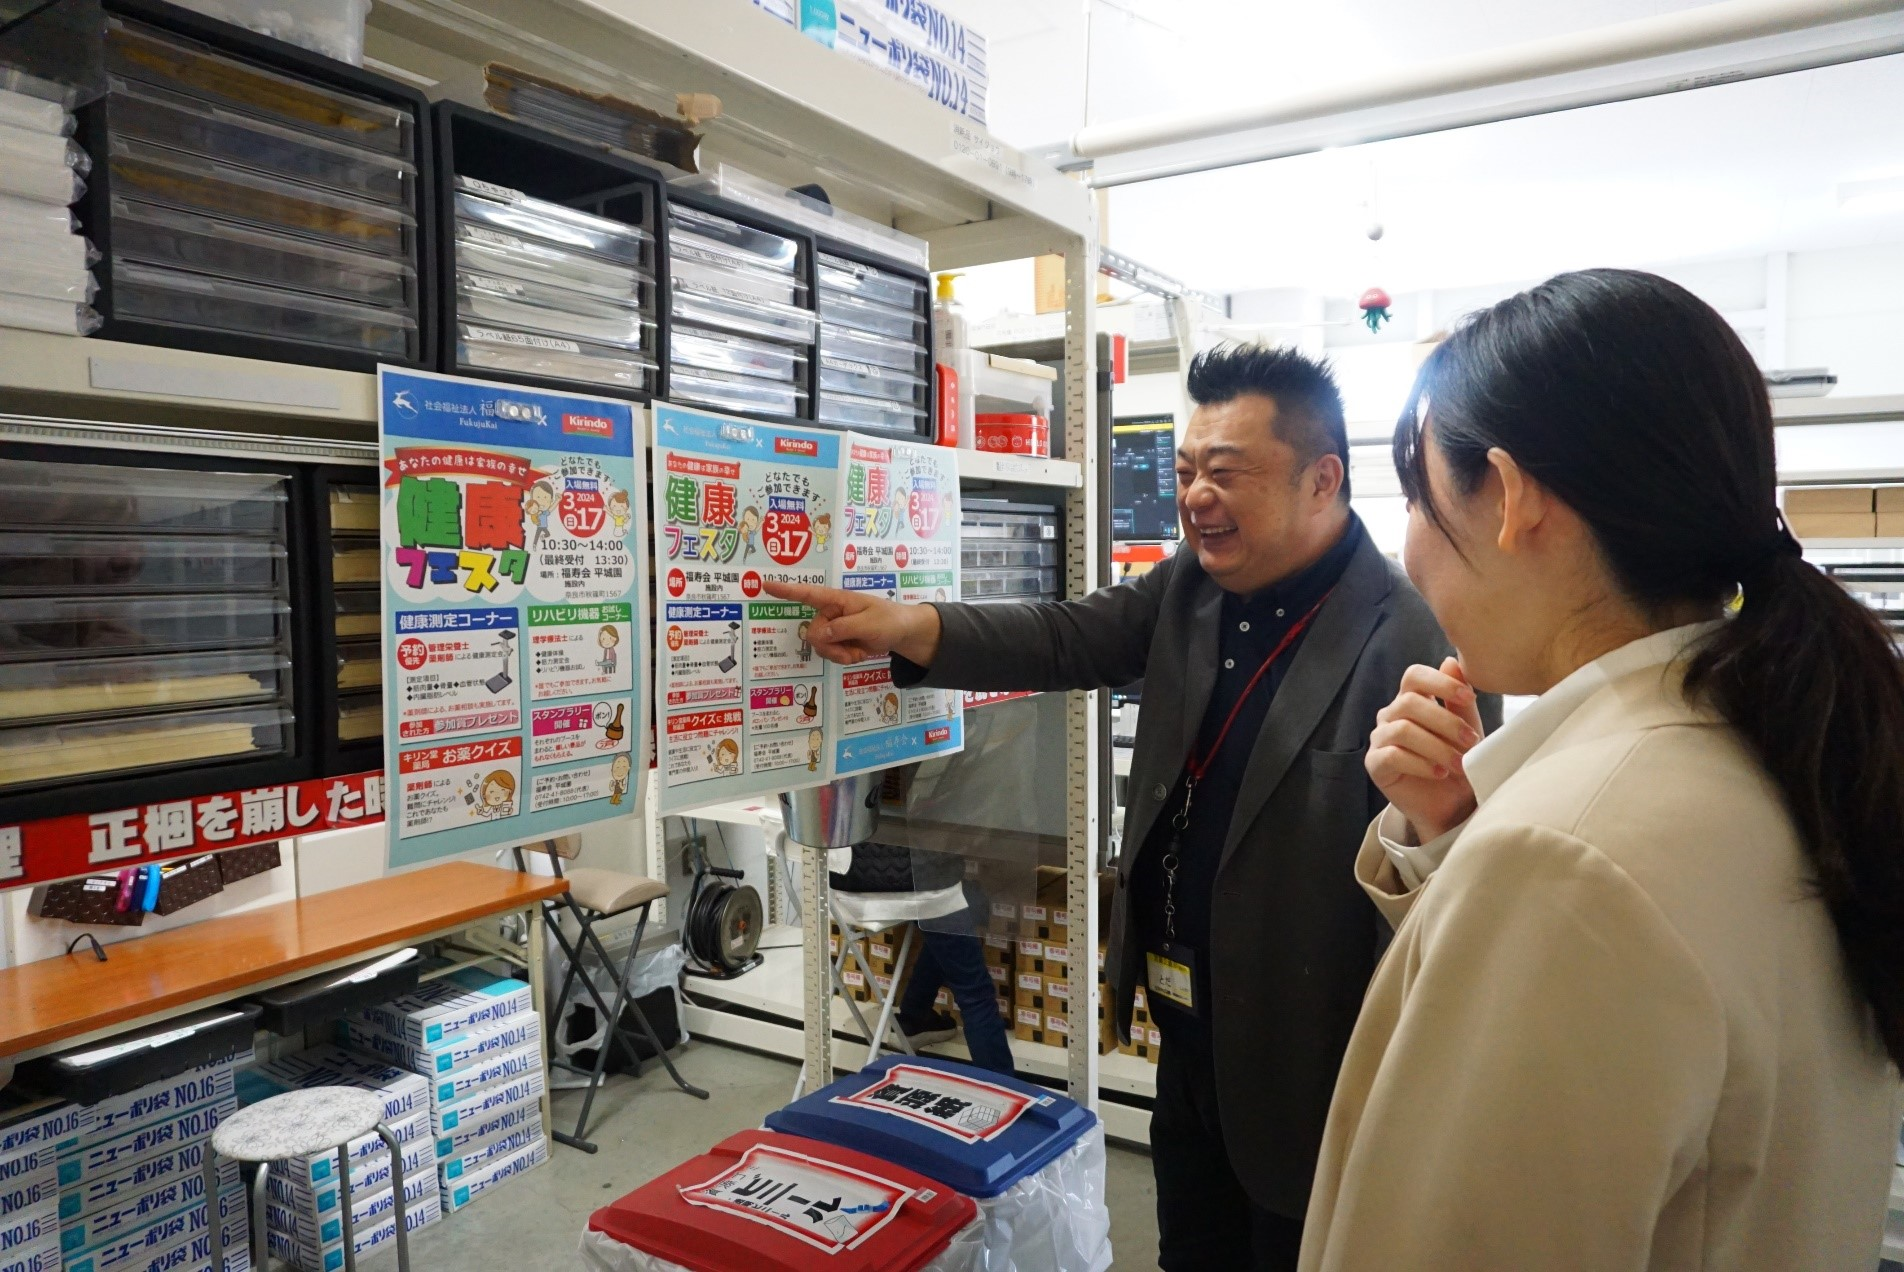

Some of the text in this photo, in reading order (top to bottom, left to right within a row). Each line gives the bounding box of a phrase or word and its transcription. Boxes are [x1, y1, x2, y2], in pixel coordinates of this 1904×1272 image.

[926, 8, 966, 64] NO.14
[928, 58, 969, 115] NO.14
[425, 401, 477, 416] 社会福祉法人
[570, 416, 608, 429] Kirindo
[780, 439, 813, 450] Kirindo
[399, 455, 527, 477] あなたの健康は家族の幸せ
[561, 456, 601, 469] どなたでも
[565, 479, 598, 490] 入場無料
[765, 472, 809, 487] どなたでも
[847, 463, 890, 507] 健康
[577, 494, 594, 503] 2024
[665, 475, 736, 526] 健康
[758, 483, 820, 502] ご参加できます
[769, 498, 805, 512] 入場無料
[781, 514, 800, 524] 2024
[844, 506, 892, 538] フェスタ
[541, 540, 623, 551] 10:30～14:00
[664, 526, 739, 562] フェスタ
[396, 547, 529, 592] フェスタ
[561, 568, 591, 579] 福寿会
[594, 568, 623, 579] 平城園
[686, 571, 739, 583] 福寿会 平城園
[400, 612, 513, 631] 健康測定コーナー
[532, 608, 600, 622] リハビリ機器
[602, 613, 629, 621] コーナー
[668, 607, 738, 619] 健康測定コーナー
[752, 606, 800, 617] リハビリ機器
[400, 644, 424, 658] 予約
[750, 687, 792, 696] スタンプラリー
[533, 706, 590, 721] スタンプラリー
[691, 713, 722, 727] クイズに
[928, 729, 948, 739] Kirindo
[404, 750, 438, 762] キリン堂
[442, 740, 511, 764] お薬クイズ
[492, 998, 517, 1021] NO.14
[501, 1026, 526, 1049] NO.14
[503, 1054, 528, 1078] NO.14
[174, 1076, 214, 1108] NO.16
[505, 1080, 530, 1105] NO.14
[867, 1084, 973, 1119] 資源紙
[385, 1094, 412, 1119] NO.14
[178, 1107, 218, 1140] NO.16
[501, 1107, 525, 1131] NO.14
[0, 1111, 79, 1151] ポリ袋 NO.16
[507, 1127, 531, 1152] NO.14
[0, 1152, 38, 1181] NO.16
[513, 1151, 535, 1175] NO.14
[1, 1184, 41, 1216] NO.16
[352, 1180, 423, 1224] ューポリ袋 O.14
[732, 1173, 842, 1223] ビニール
[1, 1219, 41, 1251] NO.16
[354, 1208, 425, 1254] ューポリ袋 O.14
